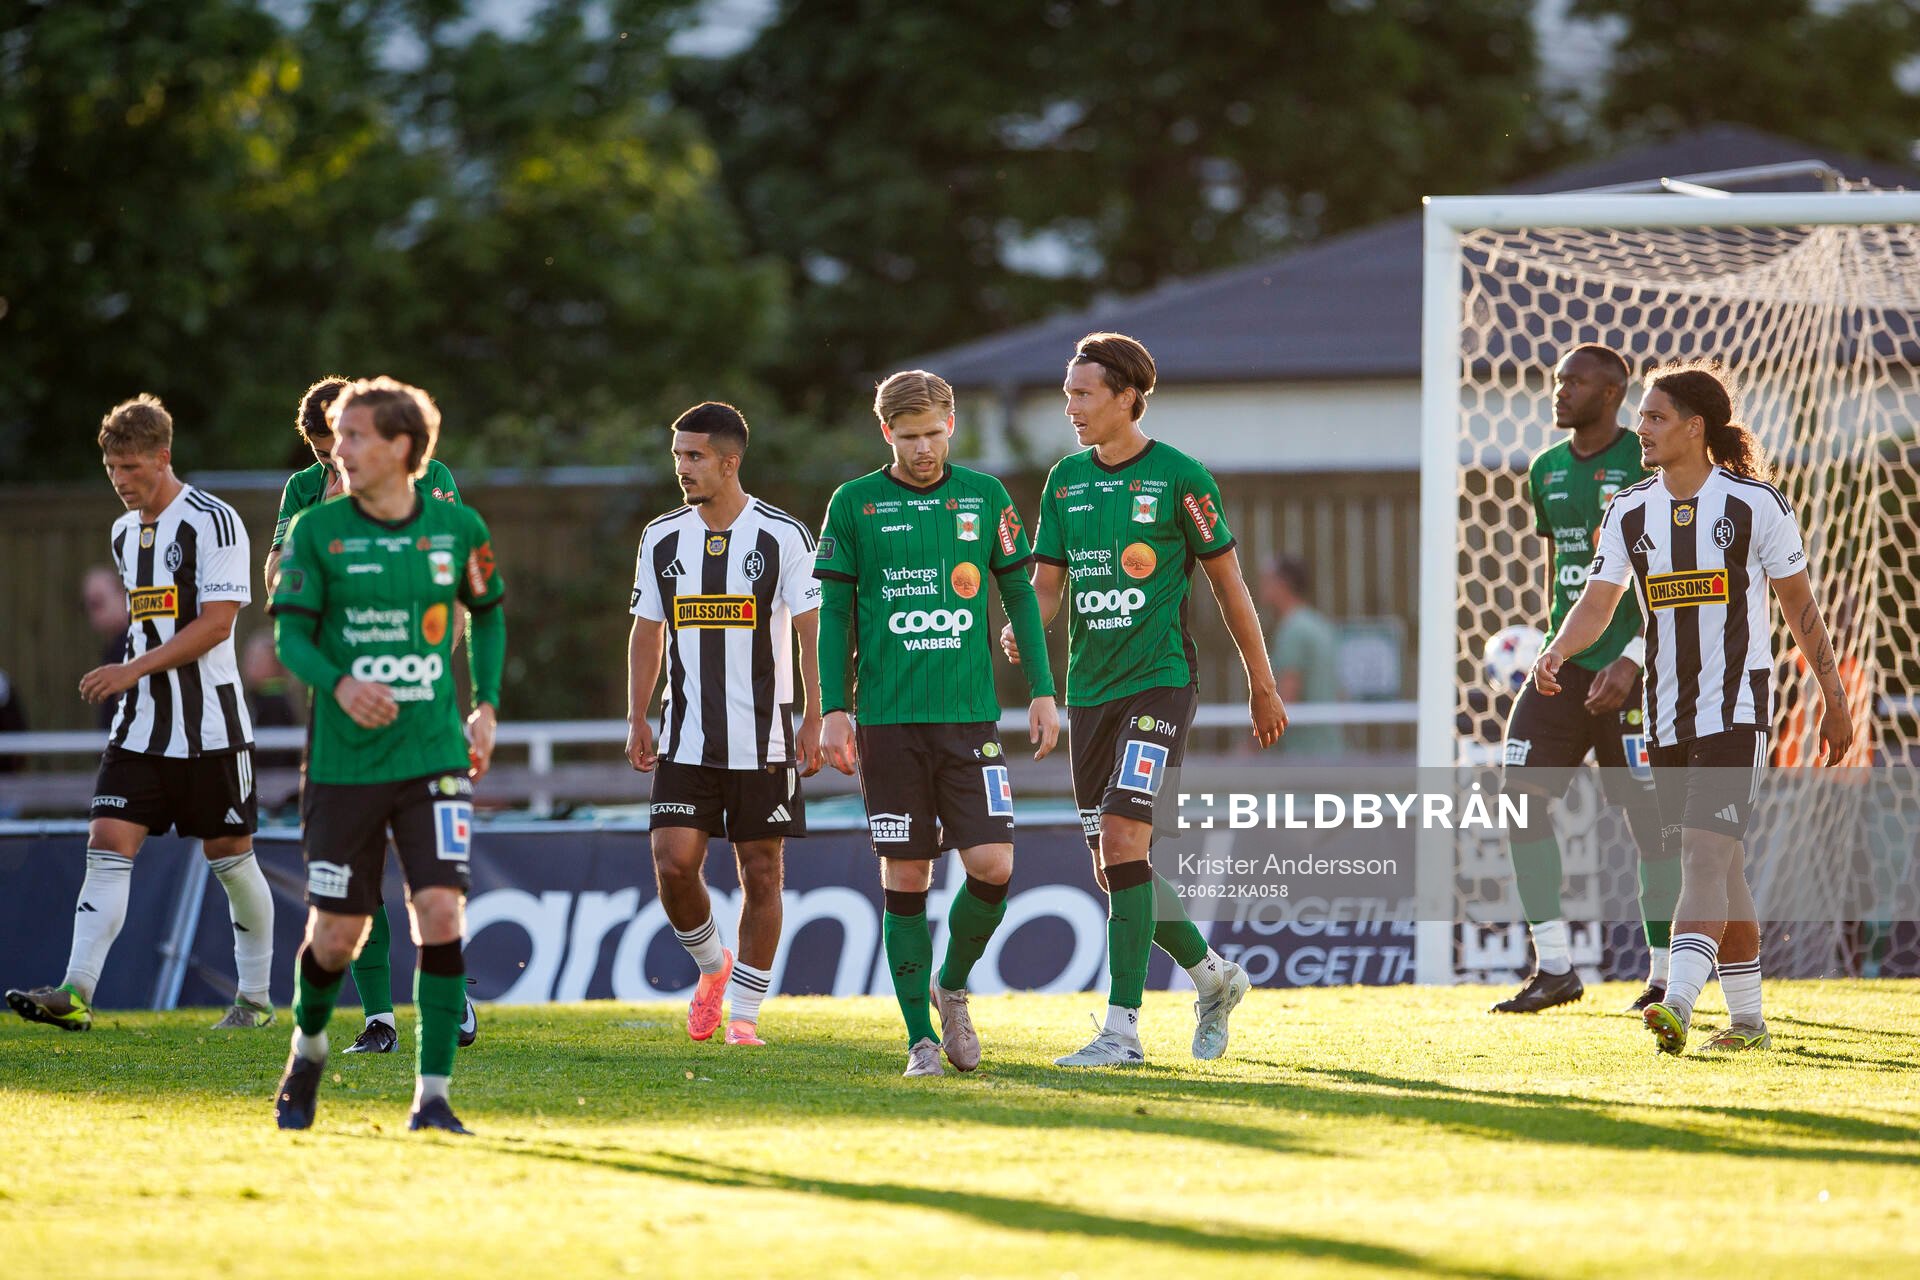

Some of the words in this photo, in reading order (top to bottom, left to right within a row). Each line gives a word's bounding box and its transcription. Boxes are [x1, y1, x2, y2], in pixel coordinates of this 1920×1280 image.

[1141, 486, 1163, 494] ENERGI
[1142, 479, 1168, 487] VARBERG
[875, 500, 902, 508] VARBERG
[1068, 505, 1088, 513] CRAFT
[1004, 503, 1022, 540] ICA
[1185, 496, 1213, 541] KVANTUM
[881, 525, 906, 533] CRAFT
[882, 566, 938, 582] Varbergs
[1069, 563, 1112, 581] Sprbank
[204, 582, 248, 594] stadium
[881, 582, 939, 602] Sparbank
[1650, 580, 1712, 601] OHLSSONS
[678, 602, 742, 620] OHLSSONS
[1076, 588, 1146, 616] coop
[888, 608, 974, 637] coop
[903, 637, 962, 651] VARBERG
[351, 653, 443, 688] coop
[1217, 943, 1282, 987] TO
[1283, 944, 1377, 988] GET
